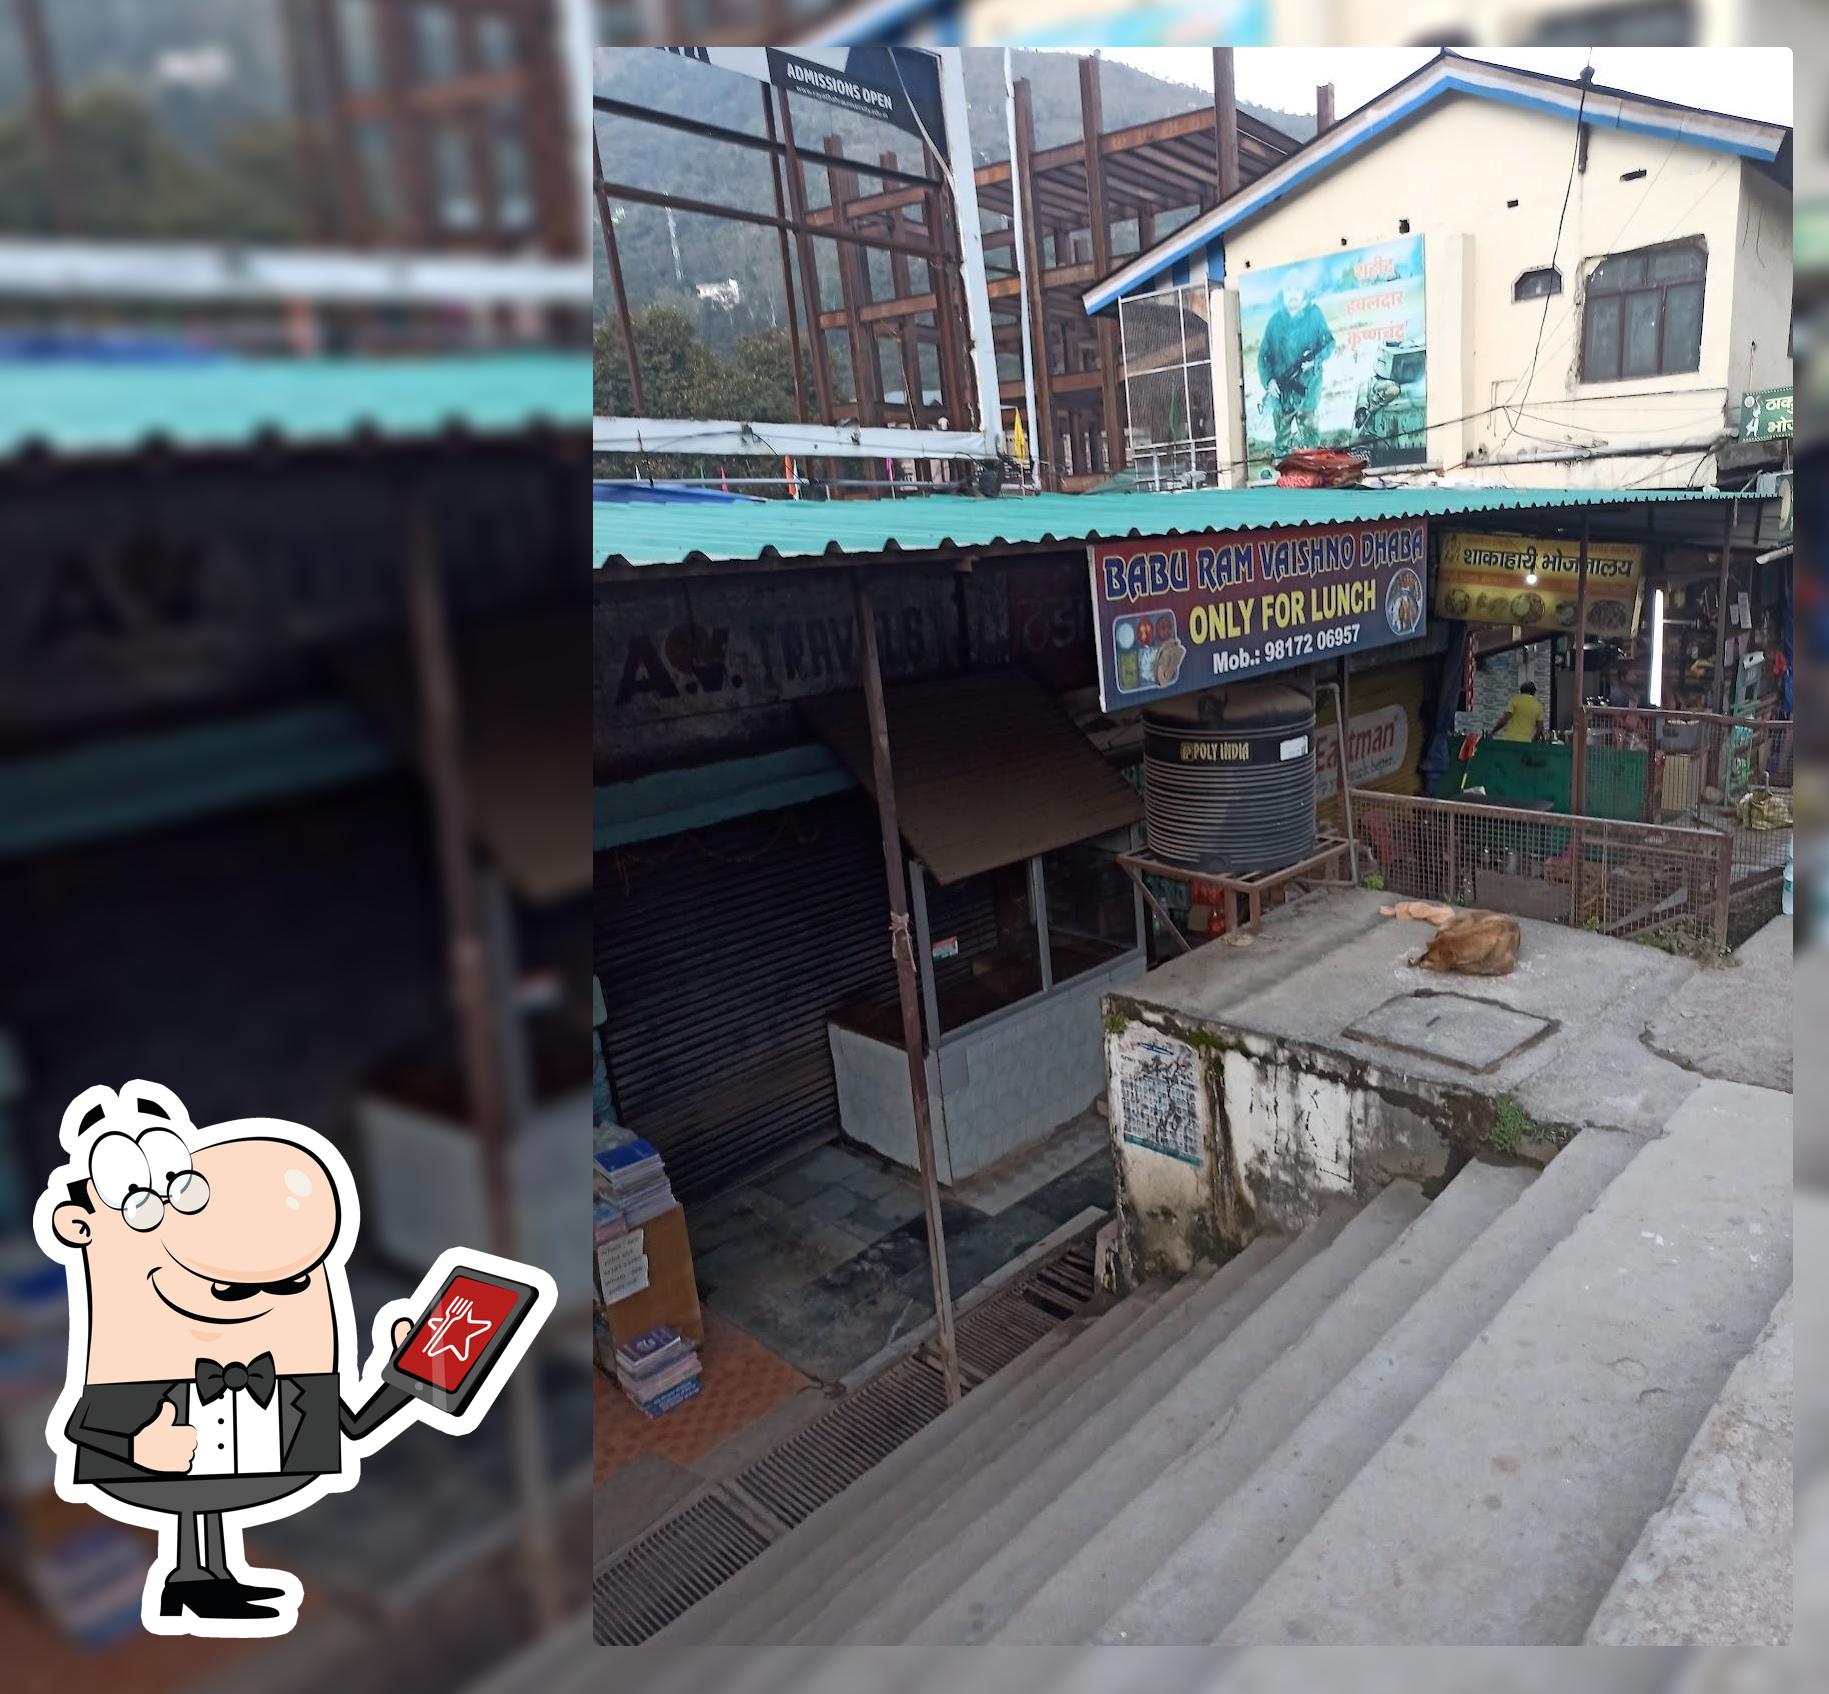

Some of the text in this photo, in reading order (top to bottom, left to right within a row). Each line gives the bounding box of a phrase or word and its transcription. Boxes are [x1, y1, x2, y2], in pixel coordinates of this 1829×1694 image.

[786, 62, 861, 100] ADMISSIONS
[862, 86, 893, 111] OPEN
[1103, 549, 1190, 603] BABU
[1196, 544, 1254, 594] RAM
[1258, 533, 1356, 581] VAISHNO
[1360, 527, 1425, 570] DHABA
[1188, 578, 1377, 646] ONLY FOR LUNCH
[1212, 623, 1361, 675] Mob.: 98172 06957
[1193, 742, 1249, 761] POLY INDIA
[1315, 720, 1396, 772] Eatman
